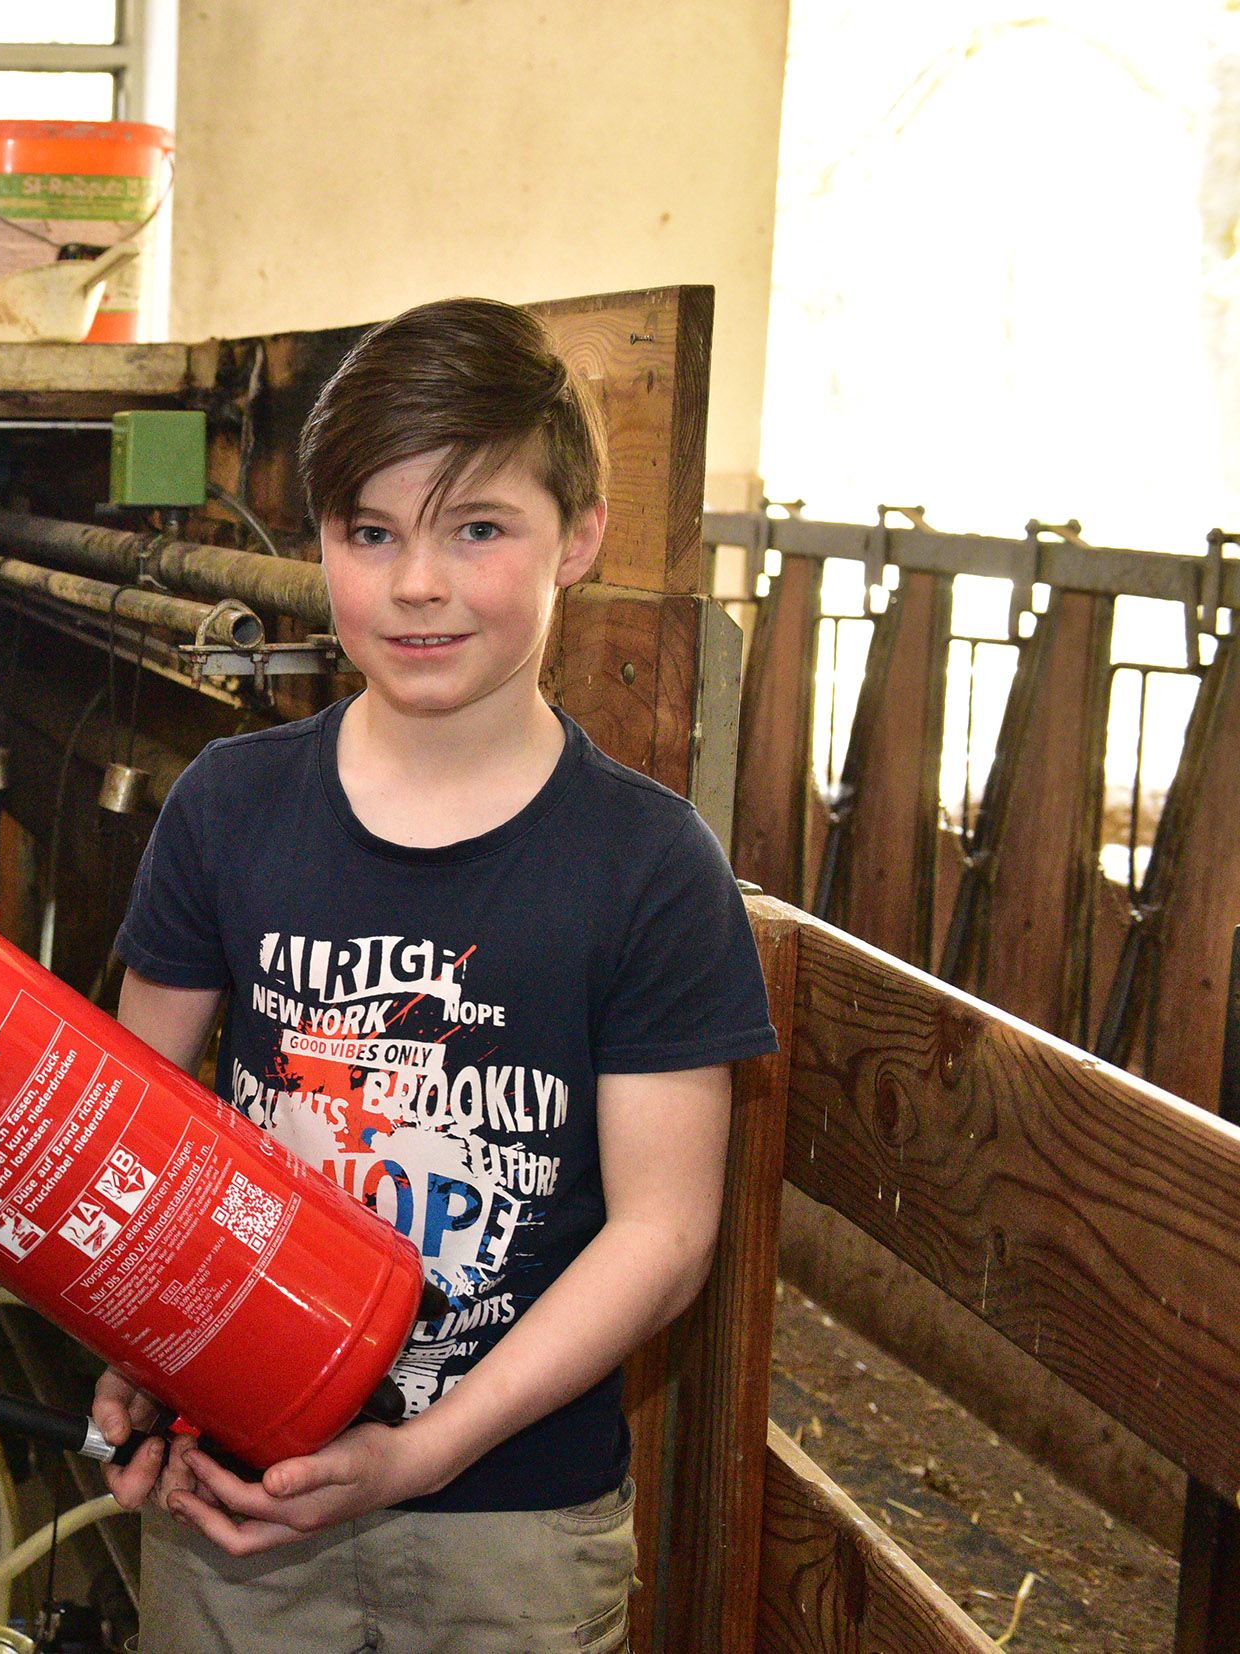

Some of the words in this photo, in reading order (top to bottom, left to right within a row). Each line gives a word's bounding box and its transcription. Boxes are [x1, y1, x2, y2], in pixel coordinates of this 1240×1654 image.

[253, 983, 304, 1028] NEW
[308, 1000, 393, 1036] YORK
[443, 1000, 506, 1027] NOPE
[289, 1035, 327, 1054] GOOD
[331, 1041, 379, 1062] VIBES
[384, 1044, 433, 1068] ONLY
[3, 1083, 39, 1125] fassen,
[34, 1050, 59, 1084] Druck-
[4, 1124, 28, 1150] kurz
[27, 1049, 77, 1123] niederdrücken
[362, 1065, 569, 1133] BROOKLYN
[9, 1118, 53, 1167] loslassen.
[12, 1175, 38, 1204] Düse
[37, 1154, 53, 1177] auf
[49, 1120, 79, 1156] Brand
[73, 1082, 106, 1120] richten,
[24, 1153, 74, 1212] Druckhebel
[72, 1079, 122, 1153] niederdrücken.
[110, 1149, 133, 1173] B
[77, 1201, 101, 1222] A
[79, 1251, 115, 1287] Vorsicht
[109, 1238, 127, 1256] bei
[125, 1180, 171, 1240] elektrischen
[166, 1140, 194, 1181] Anlagen.
[89, 1286, 107, 1302] Nur
[103, 1274, 120, 1291] bis
[116, 1251, 139, 1278] 1000
[134, 1241, 151, 1256] V;
[143, 1161, 200, 1242] Mindestabstand
